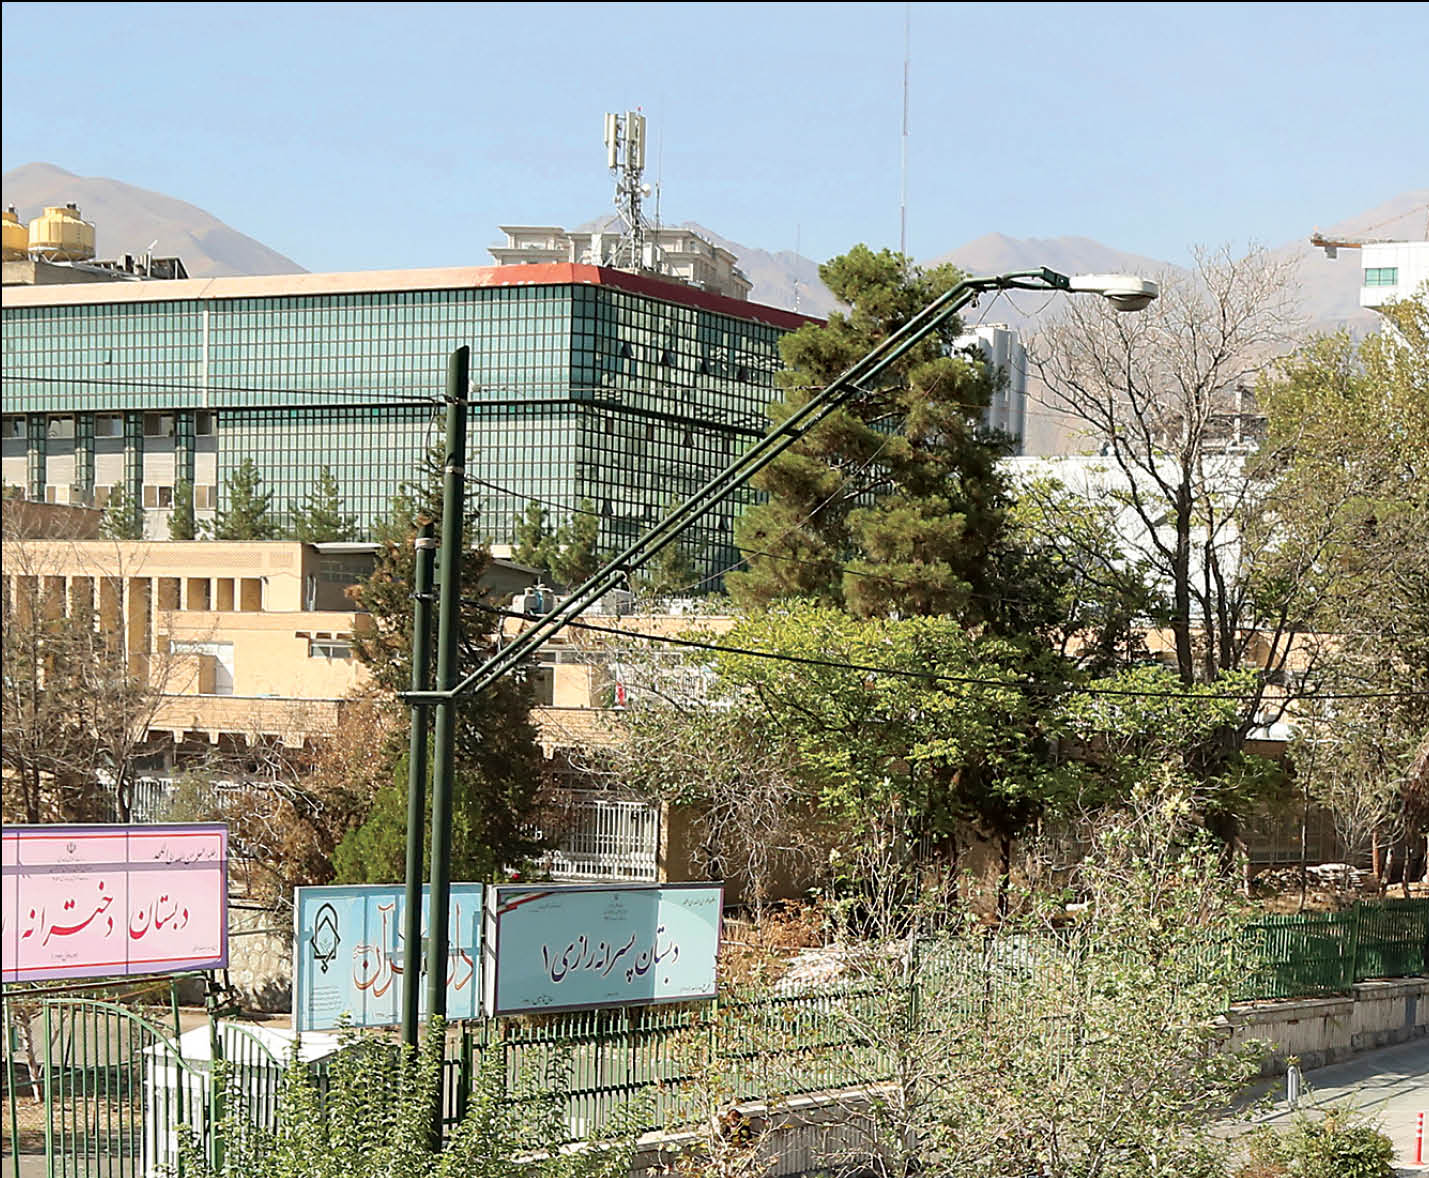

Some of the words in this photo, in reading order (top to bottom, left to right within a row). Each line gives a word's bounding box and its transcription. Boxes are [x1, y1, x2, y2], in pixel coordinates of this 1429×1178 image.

[21, 880, 114, 947] دخترانه
[129, 895, 189, 940] دبستان
[551, 935, 596, 983] رازی
[595, 933, 636, 984] پسرانه
[635, 926, 680, 984] دبستان
